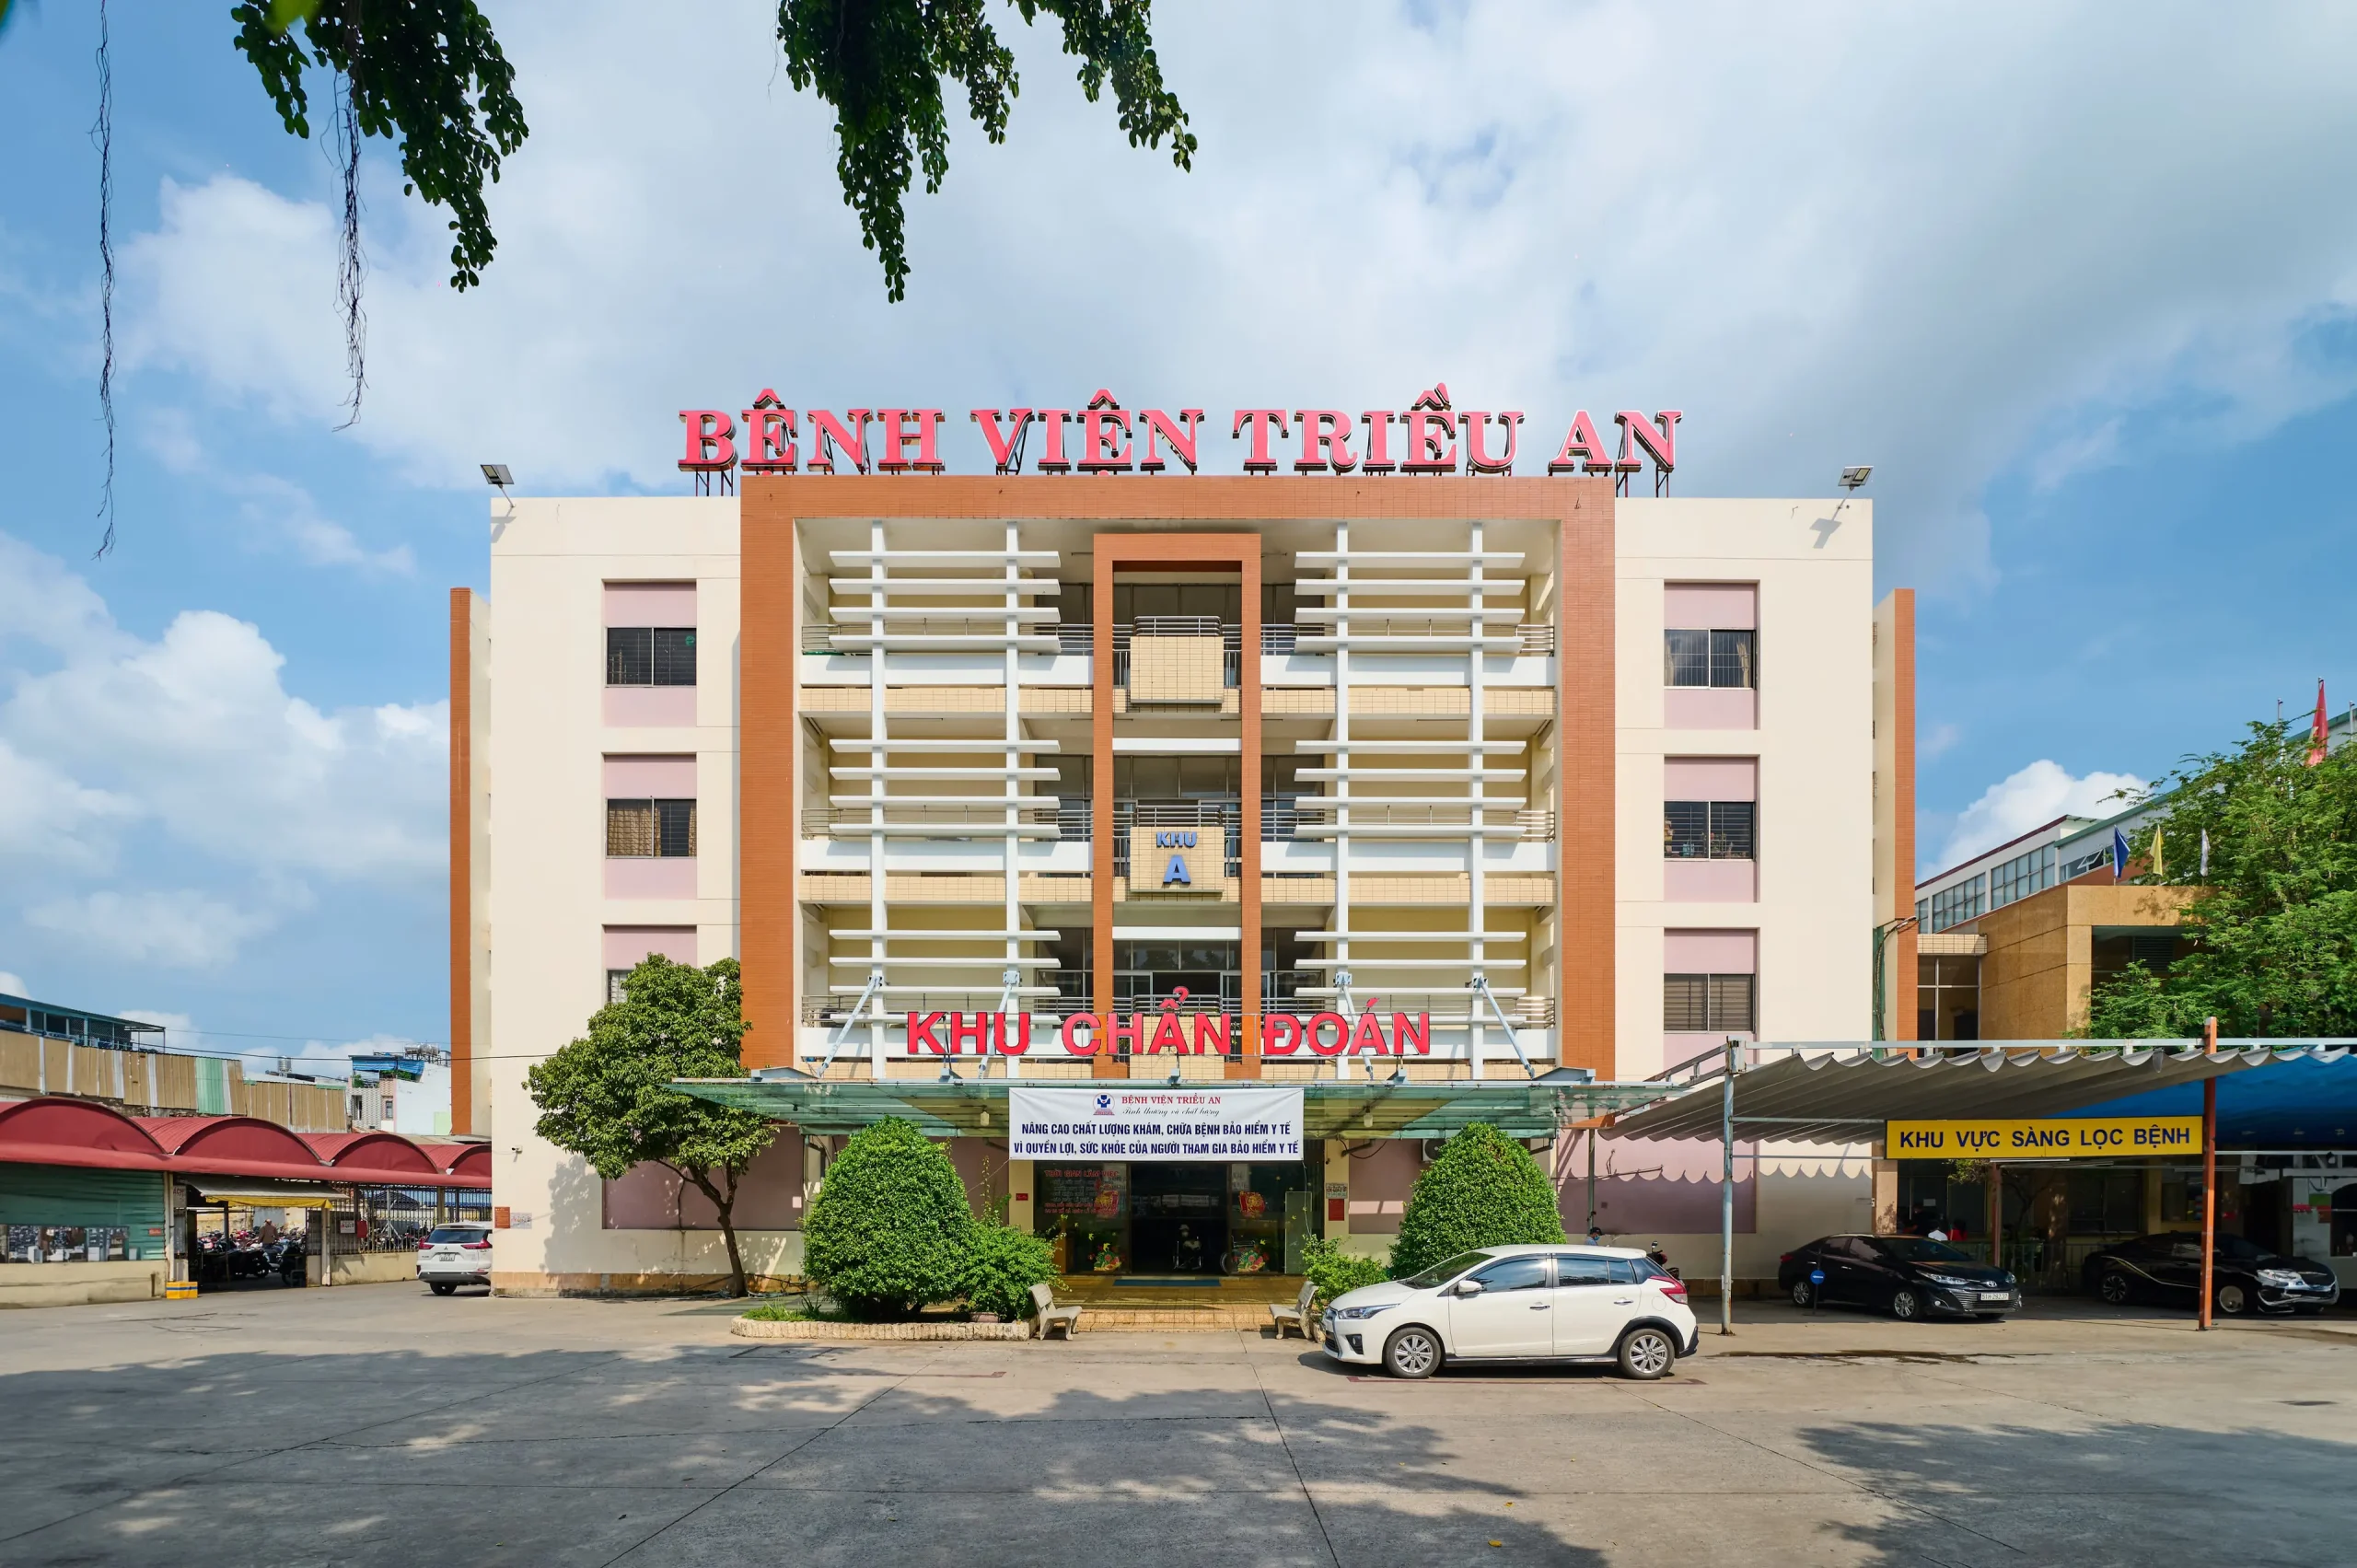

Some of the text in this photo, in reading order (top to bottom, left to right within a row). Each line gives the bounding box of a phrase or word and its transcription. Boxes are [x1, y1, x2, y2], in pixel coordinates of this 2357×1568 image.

[1233, 383, 1525, 473] TRIỀU
[1548, 410, 1683, 472] AN
[1156, 831, 1197, 848] KHU
[1162, 854, 1190, 884] A
[906, 985, 1430, 1056] KHU CHẨN ĐOÁN
[1121, 1095, 1147, 1105] BỆNH
[1151, 1095, 1173, 1105] VIỆN
[1021, 1120, 1291, 1137] NÂNG CAO CHẤT LƯỢNG KHÁM, CHỮA BỆNH BẢO HIỂM Y TẾ
[1899, 1124, 2190, 1152] KHU VỰC SÀNG LỌC BỆNH
[1014, 1141, 1023, 1154] VÌ
[1060, 1142, 1076, 1156] LỢI,
[1080, 1141, 1098, 1154] SỨC
[1101, 1140, 1126, 1154] KHỎE
[1129, 1140, 1148, 1154] CỦA
[1151, 1141, 1179, 1154] NGƯỜI
[1183, 1144, 1209, 1154] THAM
[1213, 1144, 1227, 1154] GIA
[1230, 1140, 1249, 1154] BẢO
[1252, 1139, 1276, 1154] HIỂM
[1279, 1144, 1284, 1154] Y
[1288, 1140, 1298, 1154] TẾ
